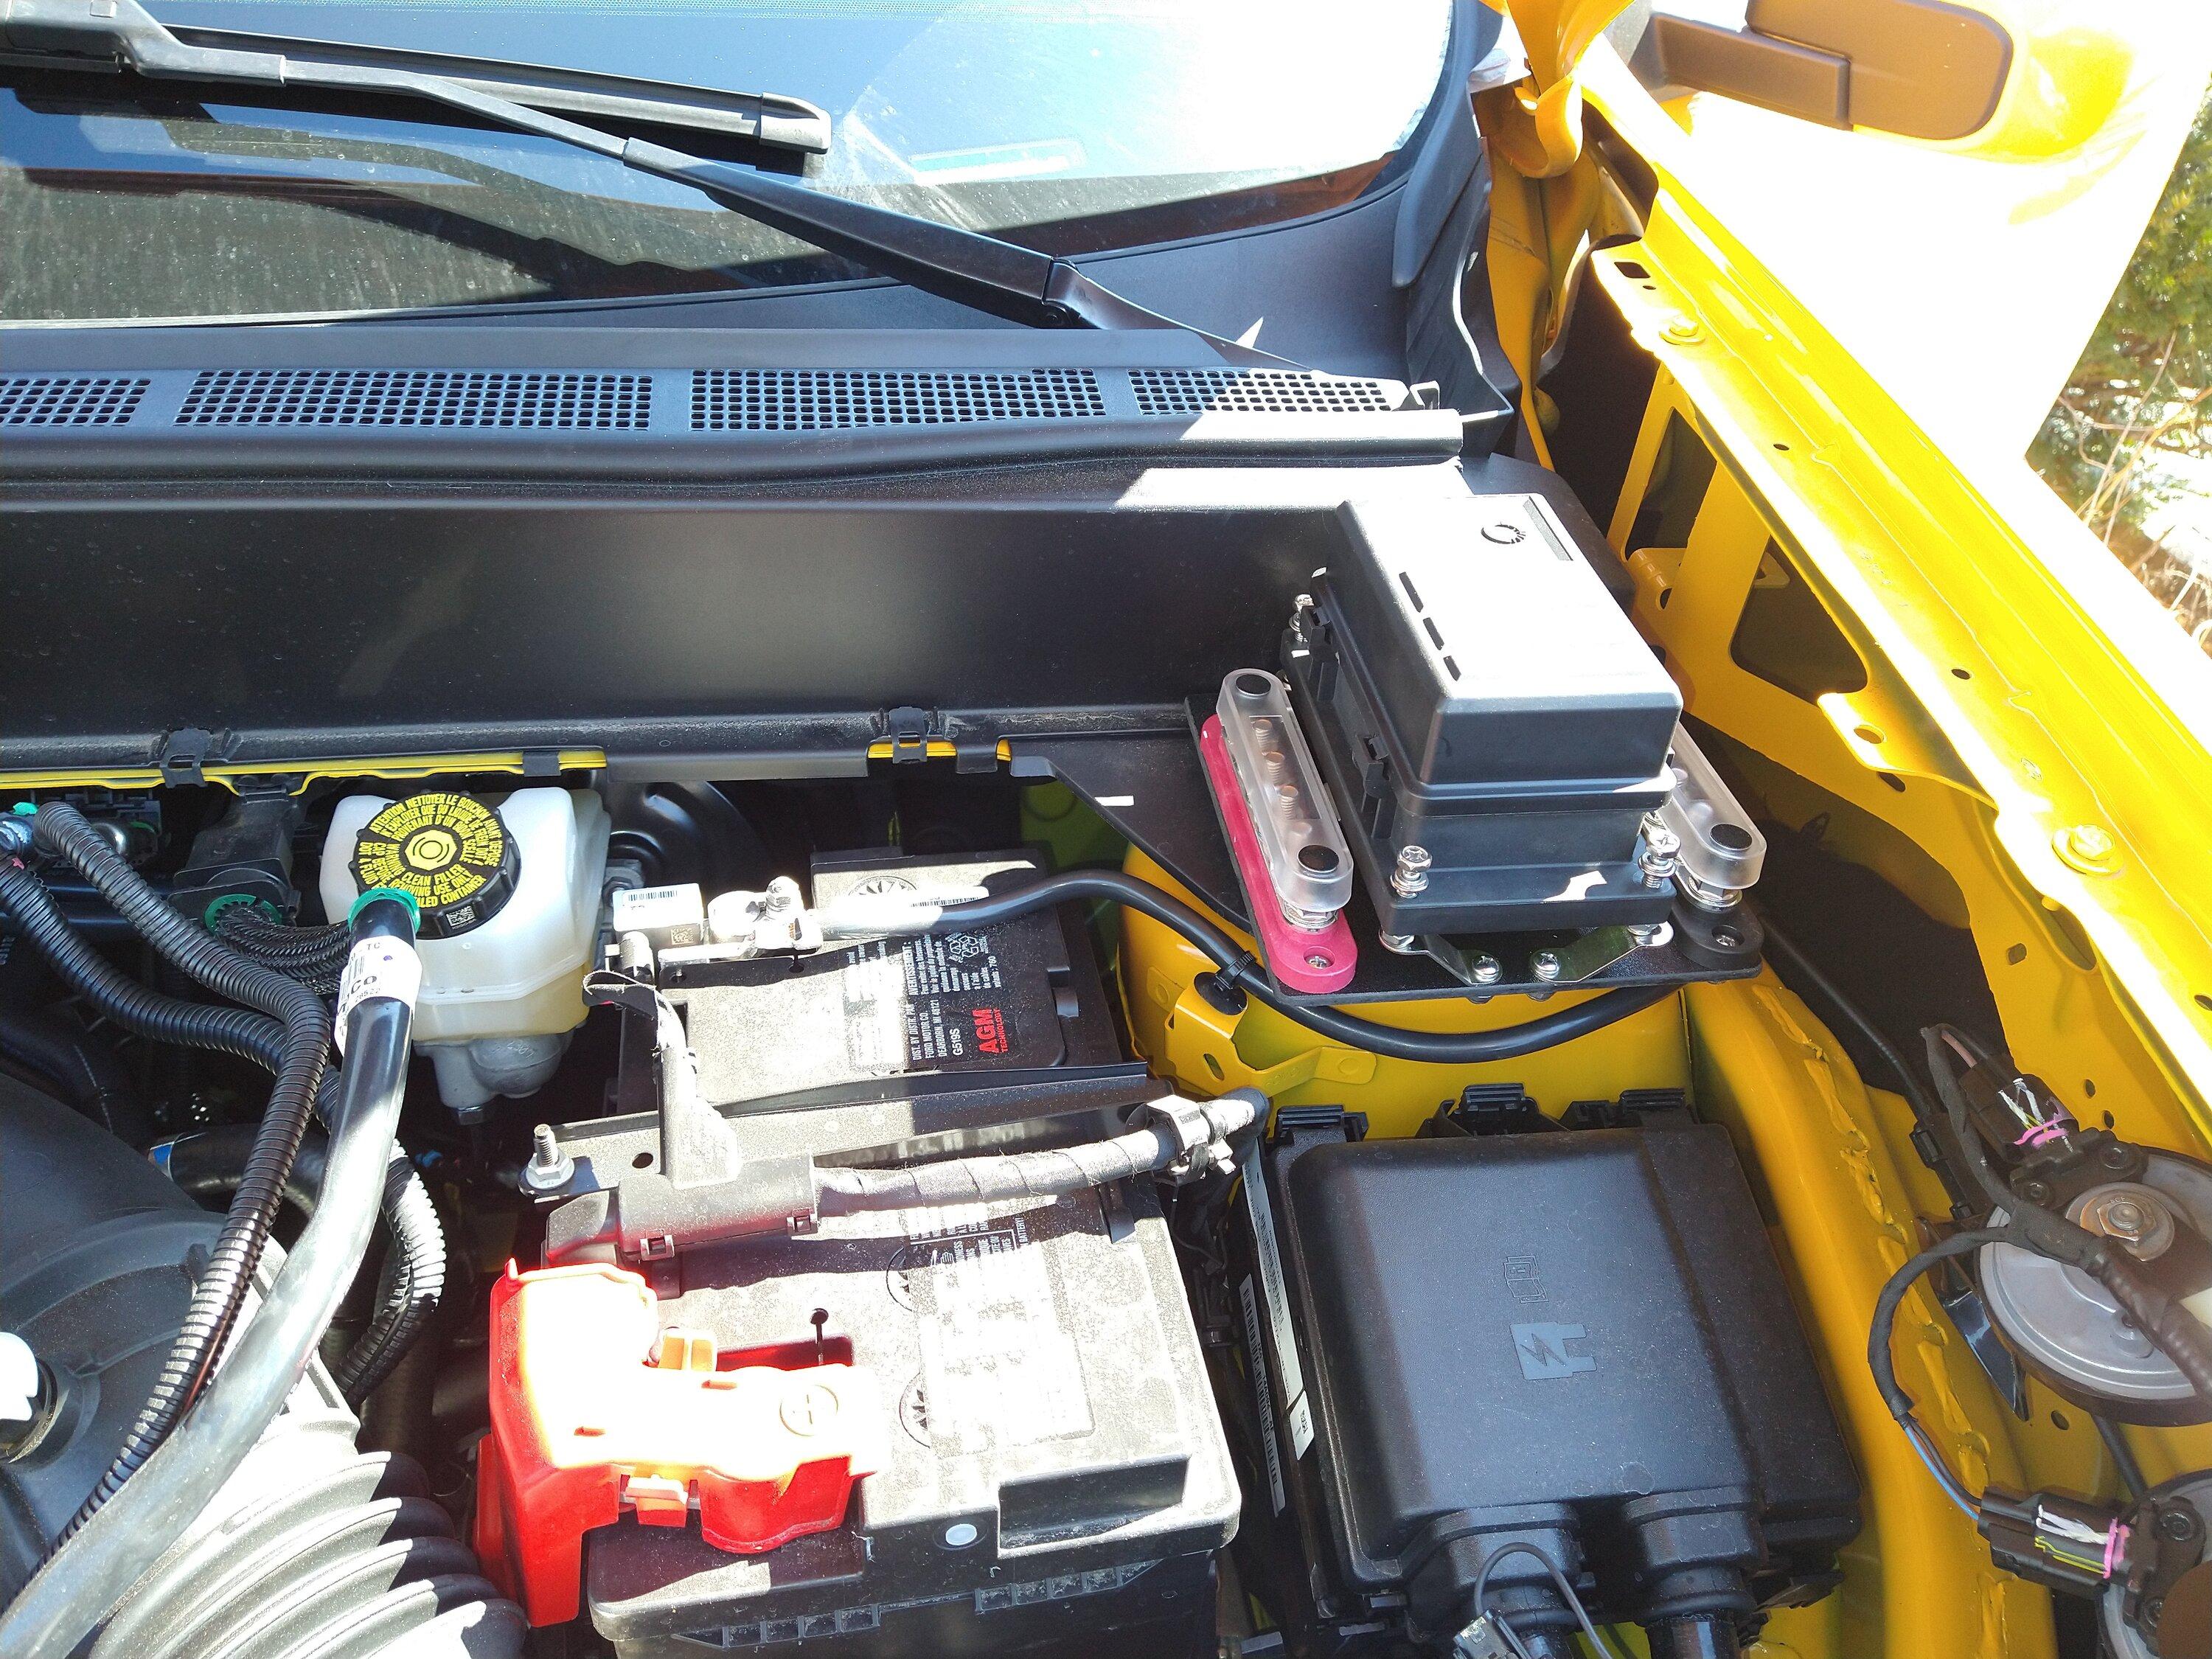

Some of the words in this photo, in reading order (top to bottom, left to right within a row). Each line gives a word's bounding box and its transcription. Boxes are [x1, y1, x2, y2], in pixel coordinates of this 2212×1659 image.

[405, 793, 446, 809] NETTOYER
[446, 794, 459, 806] LE
[420, 804, 437, 815] QUE
[437, 804, 449, 815] DU
[448, 806, 476, 824] LIQUIDE
[457, 796, 491, 821] BOUCHON
[369, 803, 406, 834] ATTENTION
[468, 819, 484, 831] DE
[391, 814, 434, 842] PROVENANT
[434, 814, 457, 828] D'UN
[482, 818, 502, 839] AVANT
[473, 827, 490, 847] FREIN
[358, 842, 374, 856] DOT
[372, 842, 387, 856] CAP
[474, 847, 490, 860] DOT
[484, 840, 503, 867] DEPOSE
[372, 857, 395, 884] BEFORE
[385, 844, 406, 876] WARNING
[401, 872, 431, 886] CLEAN
[434, 863, 466, 885] FILLER
[358, 863, 380, 885] FLUID
[451, 869, 473, 888] ONLY
[433, 882, 452, 896] USE
[440, 874, 487, 905] CONTAINER
[877, 942, 886, 956] ranking
[988, 956, 997, 967] 760
[902, 946, 919, 995] AVERTISSEMENT
[928, 965, 939, 978] guide
[980, 967, 990, 981] cables
[961, 973, 970, 990] secours
[992, 971, 1001, 987] volants
[920, 984, 929, 995] Pour
[931, 984, 939, 993] Voir
[905, 1004, 916, 1015] PAR
[919, 1010, 929, 1020] CO.
[930, 1000, 941, 1015] 48121
[908, 1016, 919, 1034] DISTR.
[921, 1021, 933, 1041] MOTOR
[971, 1009, 999, 1053] AGM
[992, 1009, 1009, 1053] TECHNOLOGY
[933, 1024, 947, 1057] DEARBORN,
[950, 1028, 964, 1056] G519S
[911, 1045, 922, 1060] DIST.
[923, 1043, 934, 1058] FORD
[1015, 1217, 1028, 1242] BATTERY!
